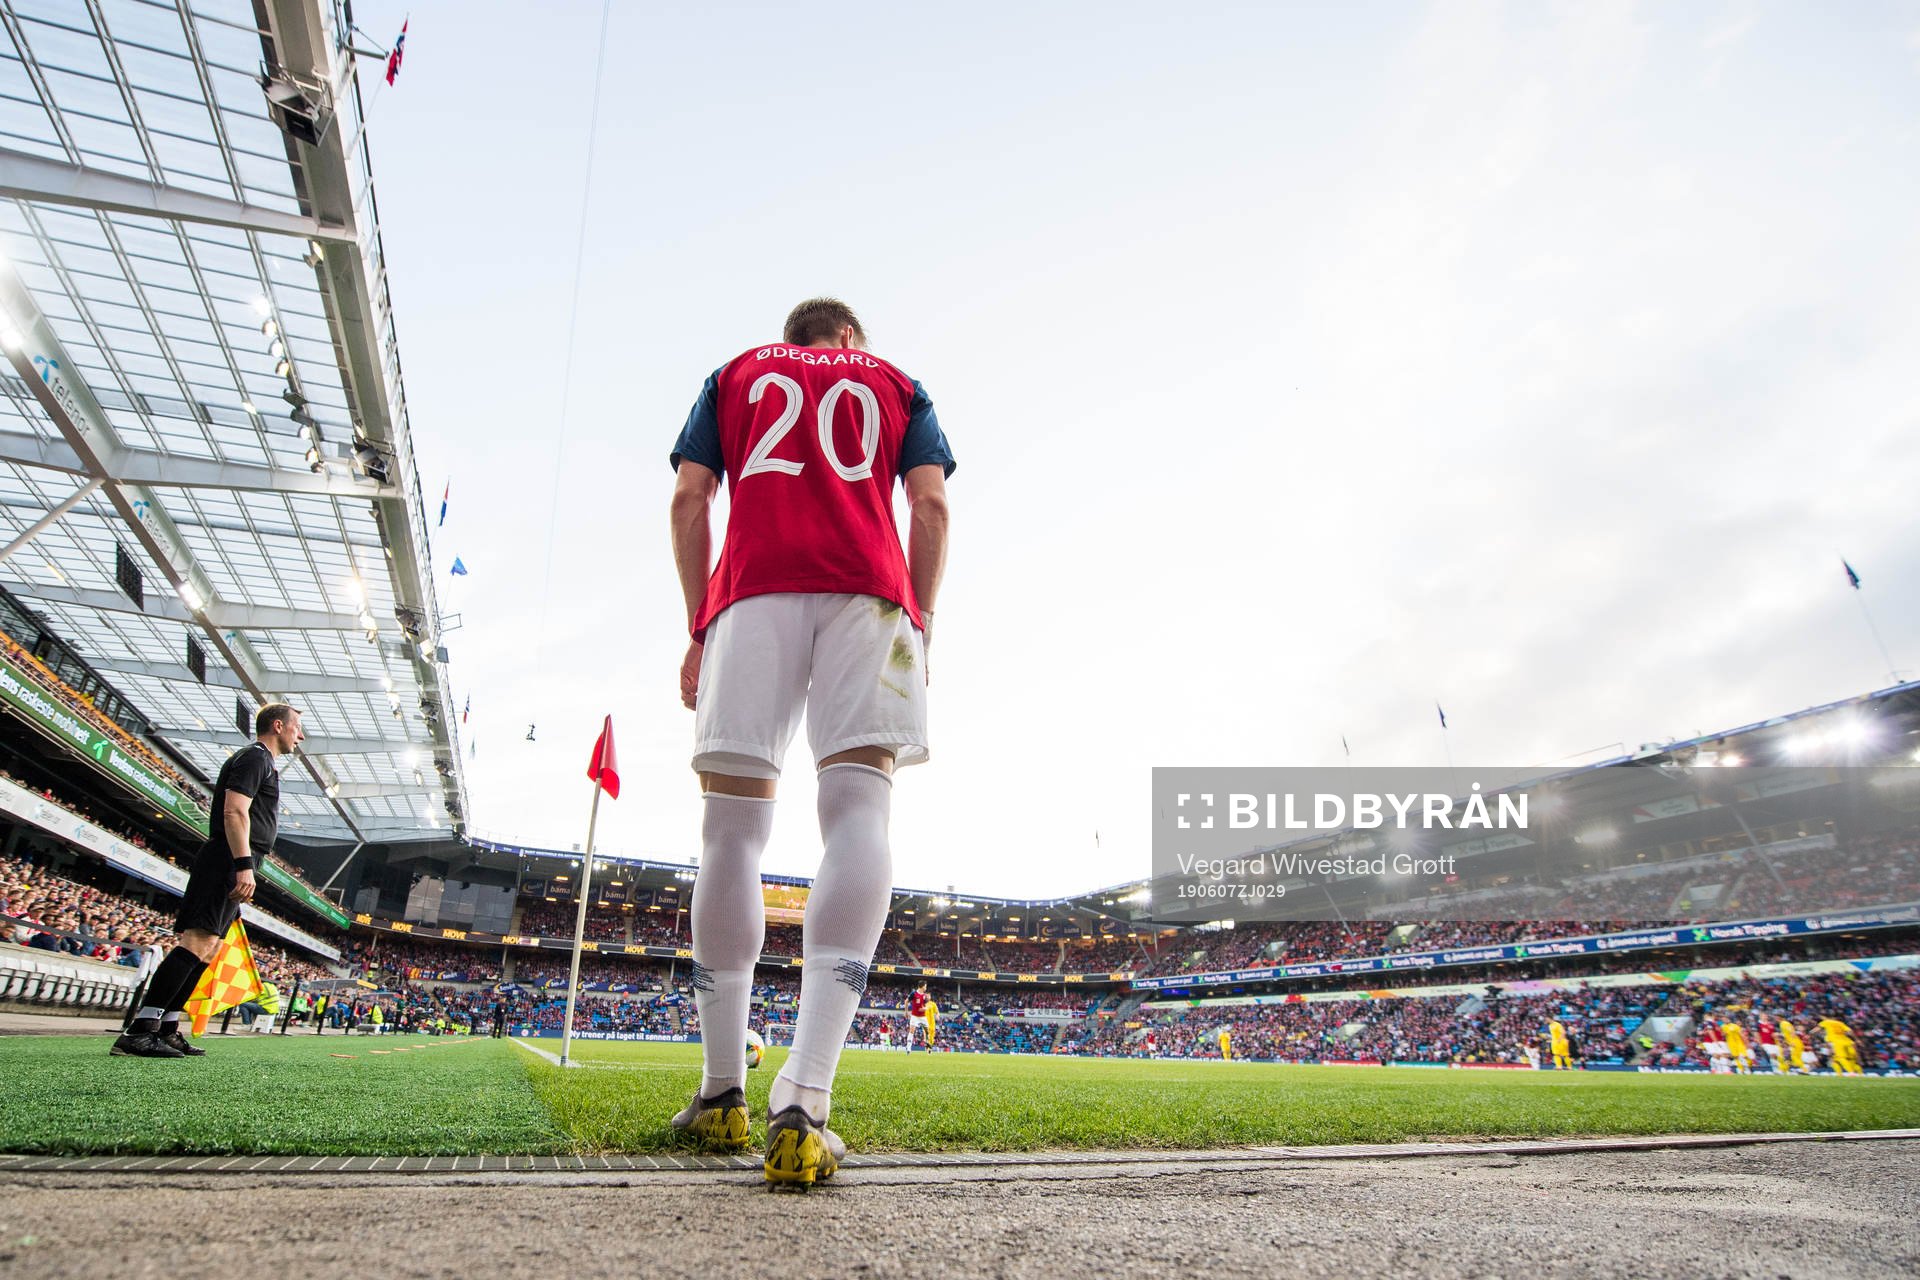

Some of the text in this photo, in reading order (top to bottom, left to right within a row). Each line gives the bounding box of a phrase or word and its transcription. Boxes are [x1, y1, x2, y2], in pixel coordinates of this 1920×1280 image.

[756, 346, 879, 368] ØDEGAARD
[51, 377, 91, 437] telenor
[739, 372, 880, 482] 20
[605, 891, 625, 899] bama
[658, 895, 678, 904] bama
[391, 921, 413, 933] MOVE
[1710, 923, 1790, 938] Norsk Tipping
[442, 929, 467, 940] MOVE
[502, 936, 520, 945] MOV
[581, 943, 599, 951] OVE
[624, 945, 647, 954] MOVE
[676, 949, 693, 957] MOV
[606, 1031, 616, 1041] på
[617, 1032, 636, 1041] laget
[637, 1032, 645, 1040] til
[672, 1033, 688, 1042] din?
